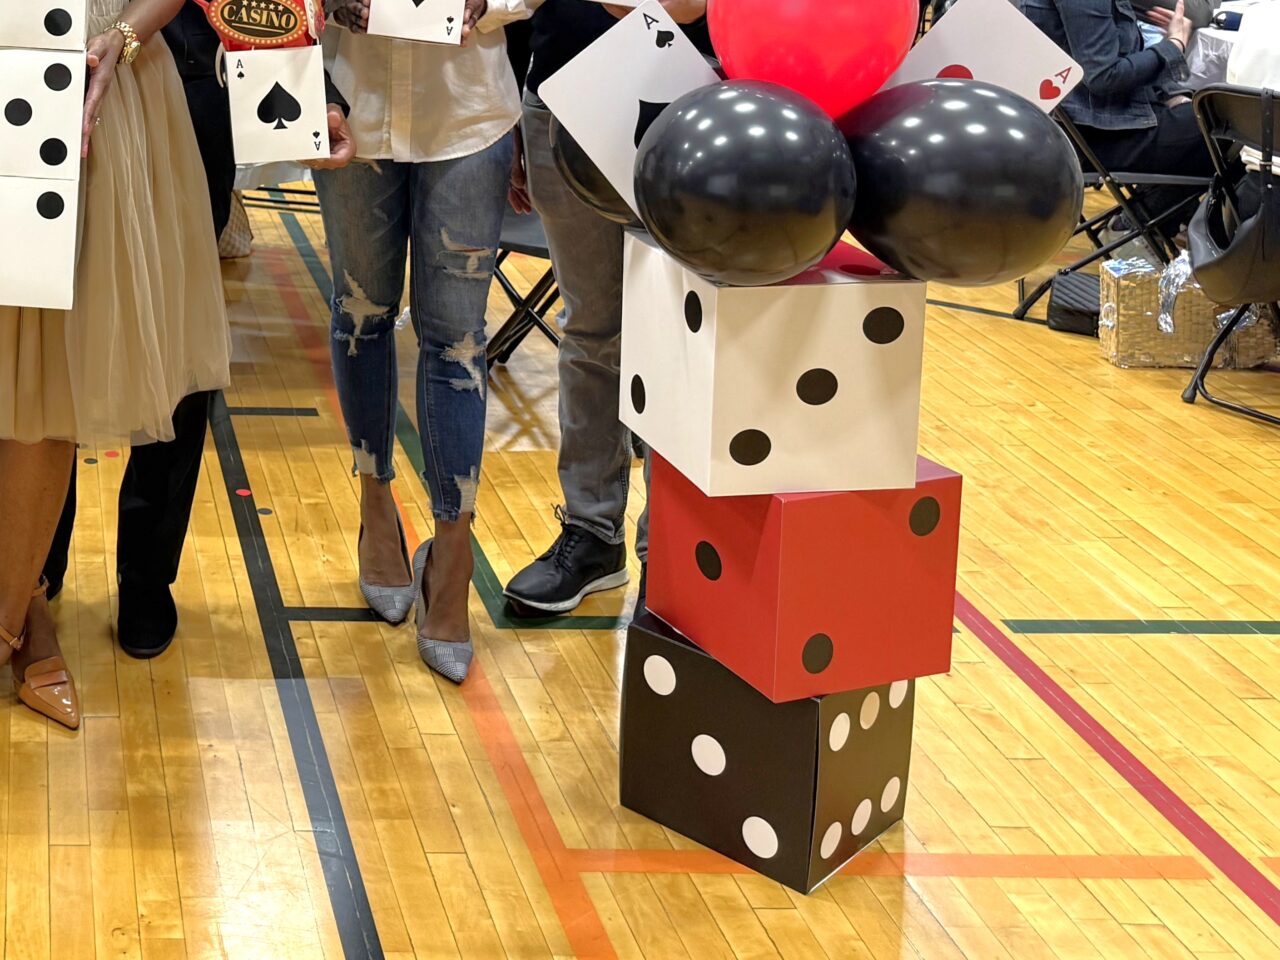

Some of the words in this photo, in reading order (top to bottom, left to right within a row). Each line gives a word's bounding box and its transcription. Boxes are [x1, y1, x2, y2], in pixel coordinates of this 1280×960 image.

[223, 4, 296, 29] CASINO
[642, 12, 660, 30] A
[446, 26, 454, 36] A
[236, 59, 244, 69] A
[1054, 66, 1072, 85] A
[314, 141, 322, 151] A
